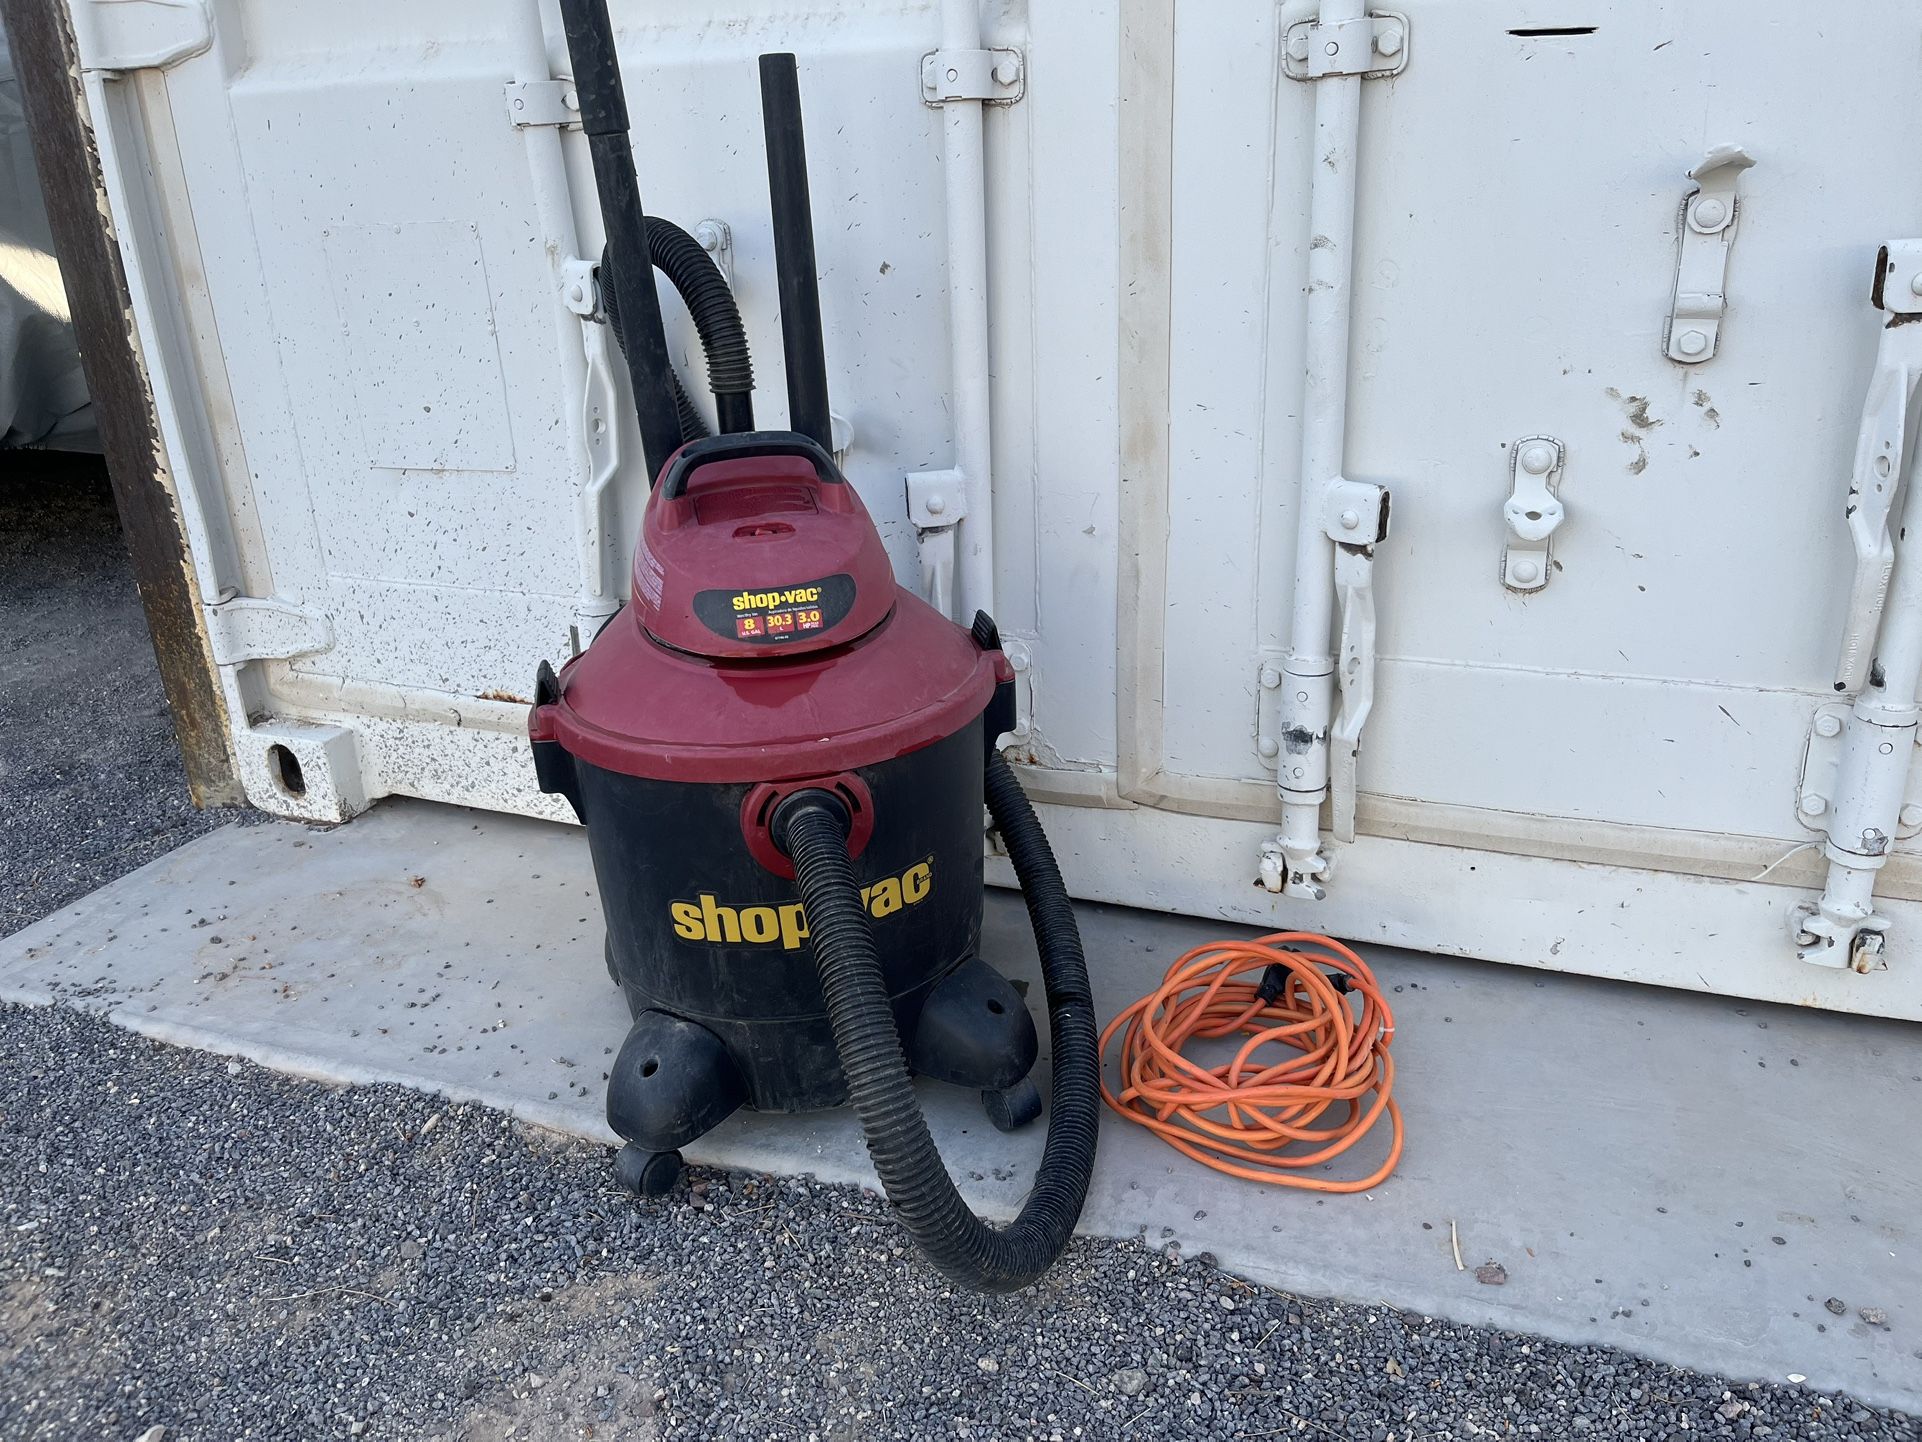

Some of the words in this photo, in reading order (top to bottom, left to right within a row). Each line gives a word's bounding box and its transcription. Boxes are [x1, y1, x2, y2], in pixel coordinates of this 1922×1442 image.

[767, 613, 792, 627] 30.3
[798, 610, 820, 623] 3.0
[743, 618, 755, 630] 8
[671, 894, 810, 950] shop
